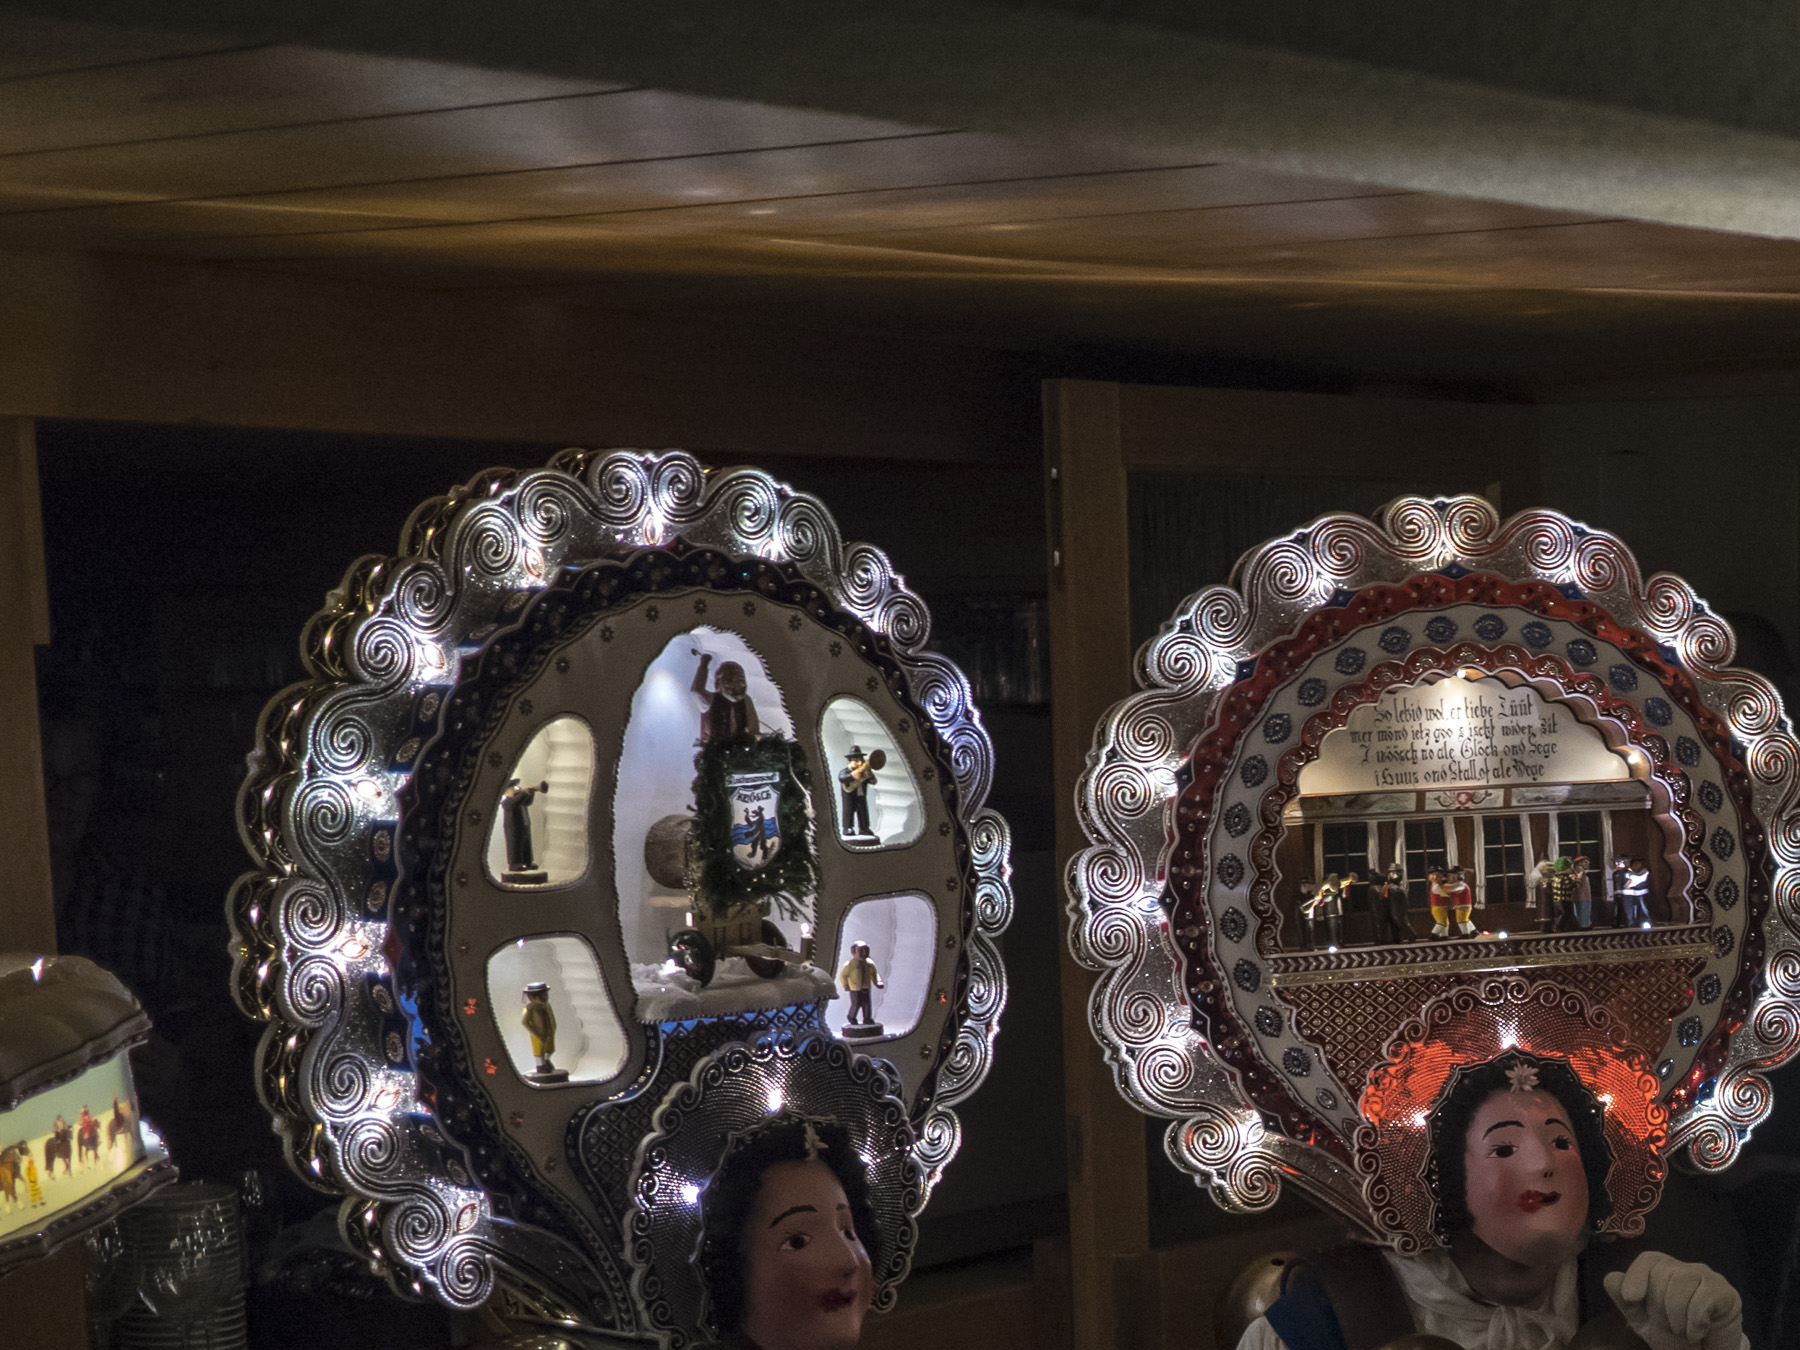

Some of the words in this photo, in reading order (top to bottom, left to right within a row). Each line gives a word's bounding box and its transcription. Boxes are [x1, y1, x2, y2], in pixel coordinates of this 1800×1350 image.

[1450, 706, 1462, 720] er
[1350, 731, 1373, 744] mer
[1421, 749, 1435, 761] no
[1437, 741, 1455, 760] ale
[1460, 737, 1498, 760] Glöck
[1503, 738, 1526, 757] ond
[1528, 733, 1557, 759] Sege
[1424, 763, 1447, 783] ond
[1492, 758, 1511, 779] ale
